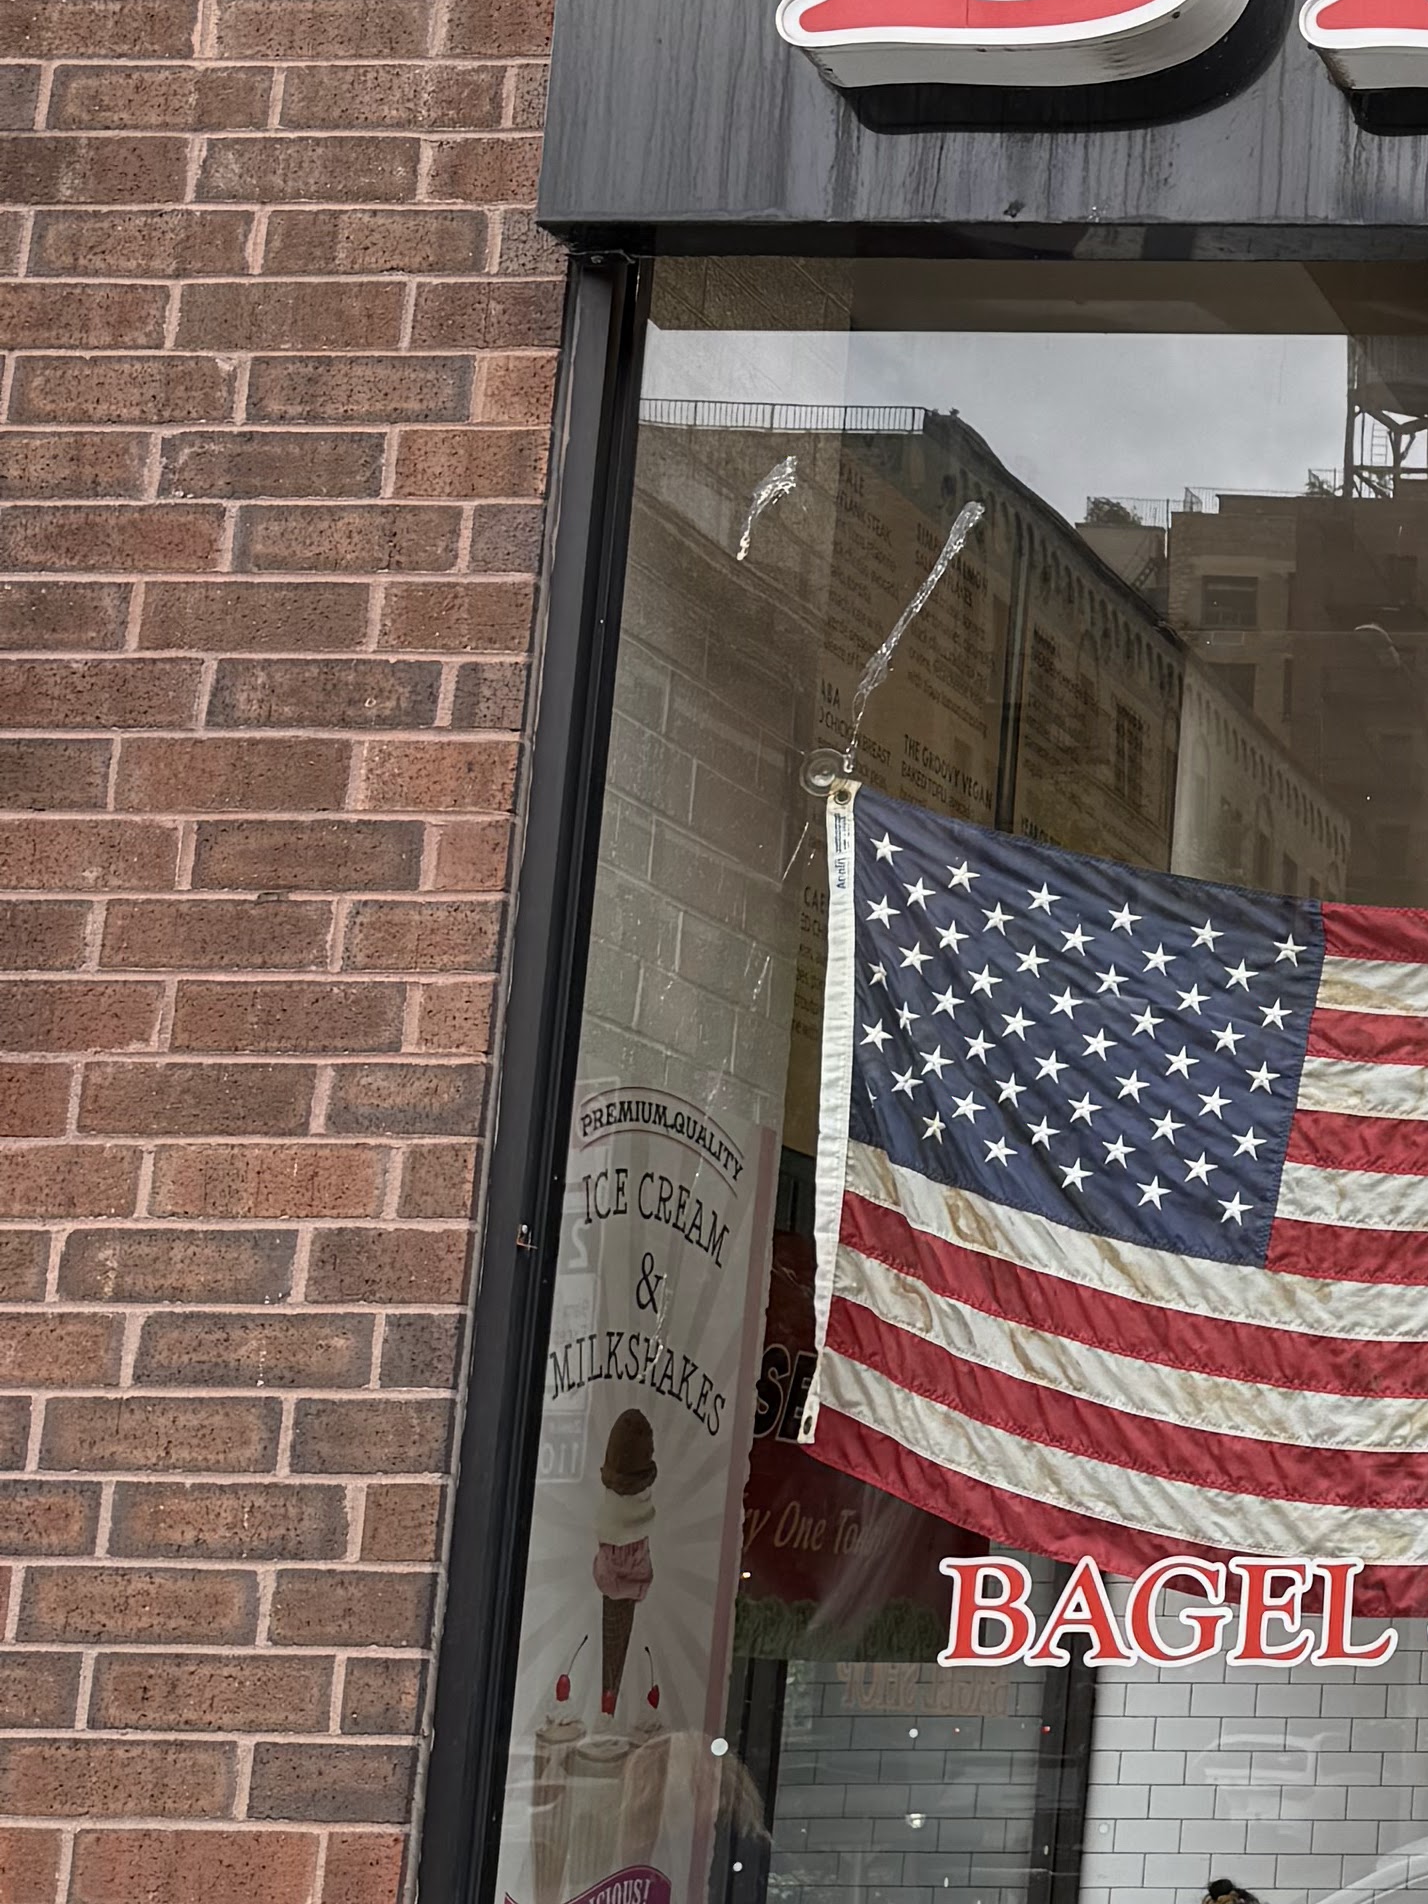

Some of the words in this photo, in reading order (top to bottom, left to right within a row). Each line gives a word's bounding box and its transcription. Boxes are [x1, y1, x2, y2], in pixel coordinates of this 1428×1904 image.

[580, 1099, 669, 1139] PREMIUM
[669, 1111, 744, 1183] QUALITY
[582, 1168, 629, 1225] ICE
[637, 1170, 730, 1270] CREAM
[635, 1252, 663, 1314] &
[549, 1331, 727, 1437] MILKSHAKES
[772, 1499, 828, 1551] One
[936, 1553, 1399, 1667] BAGEL
